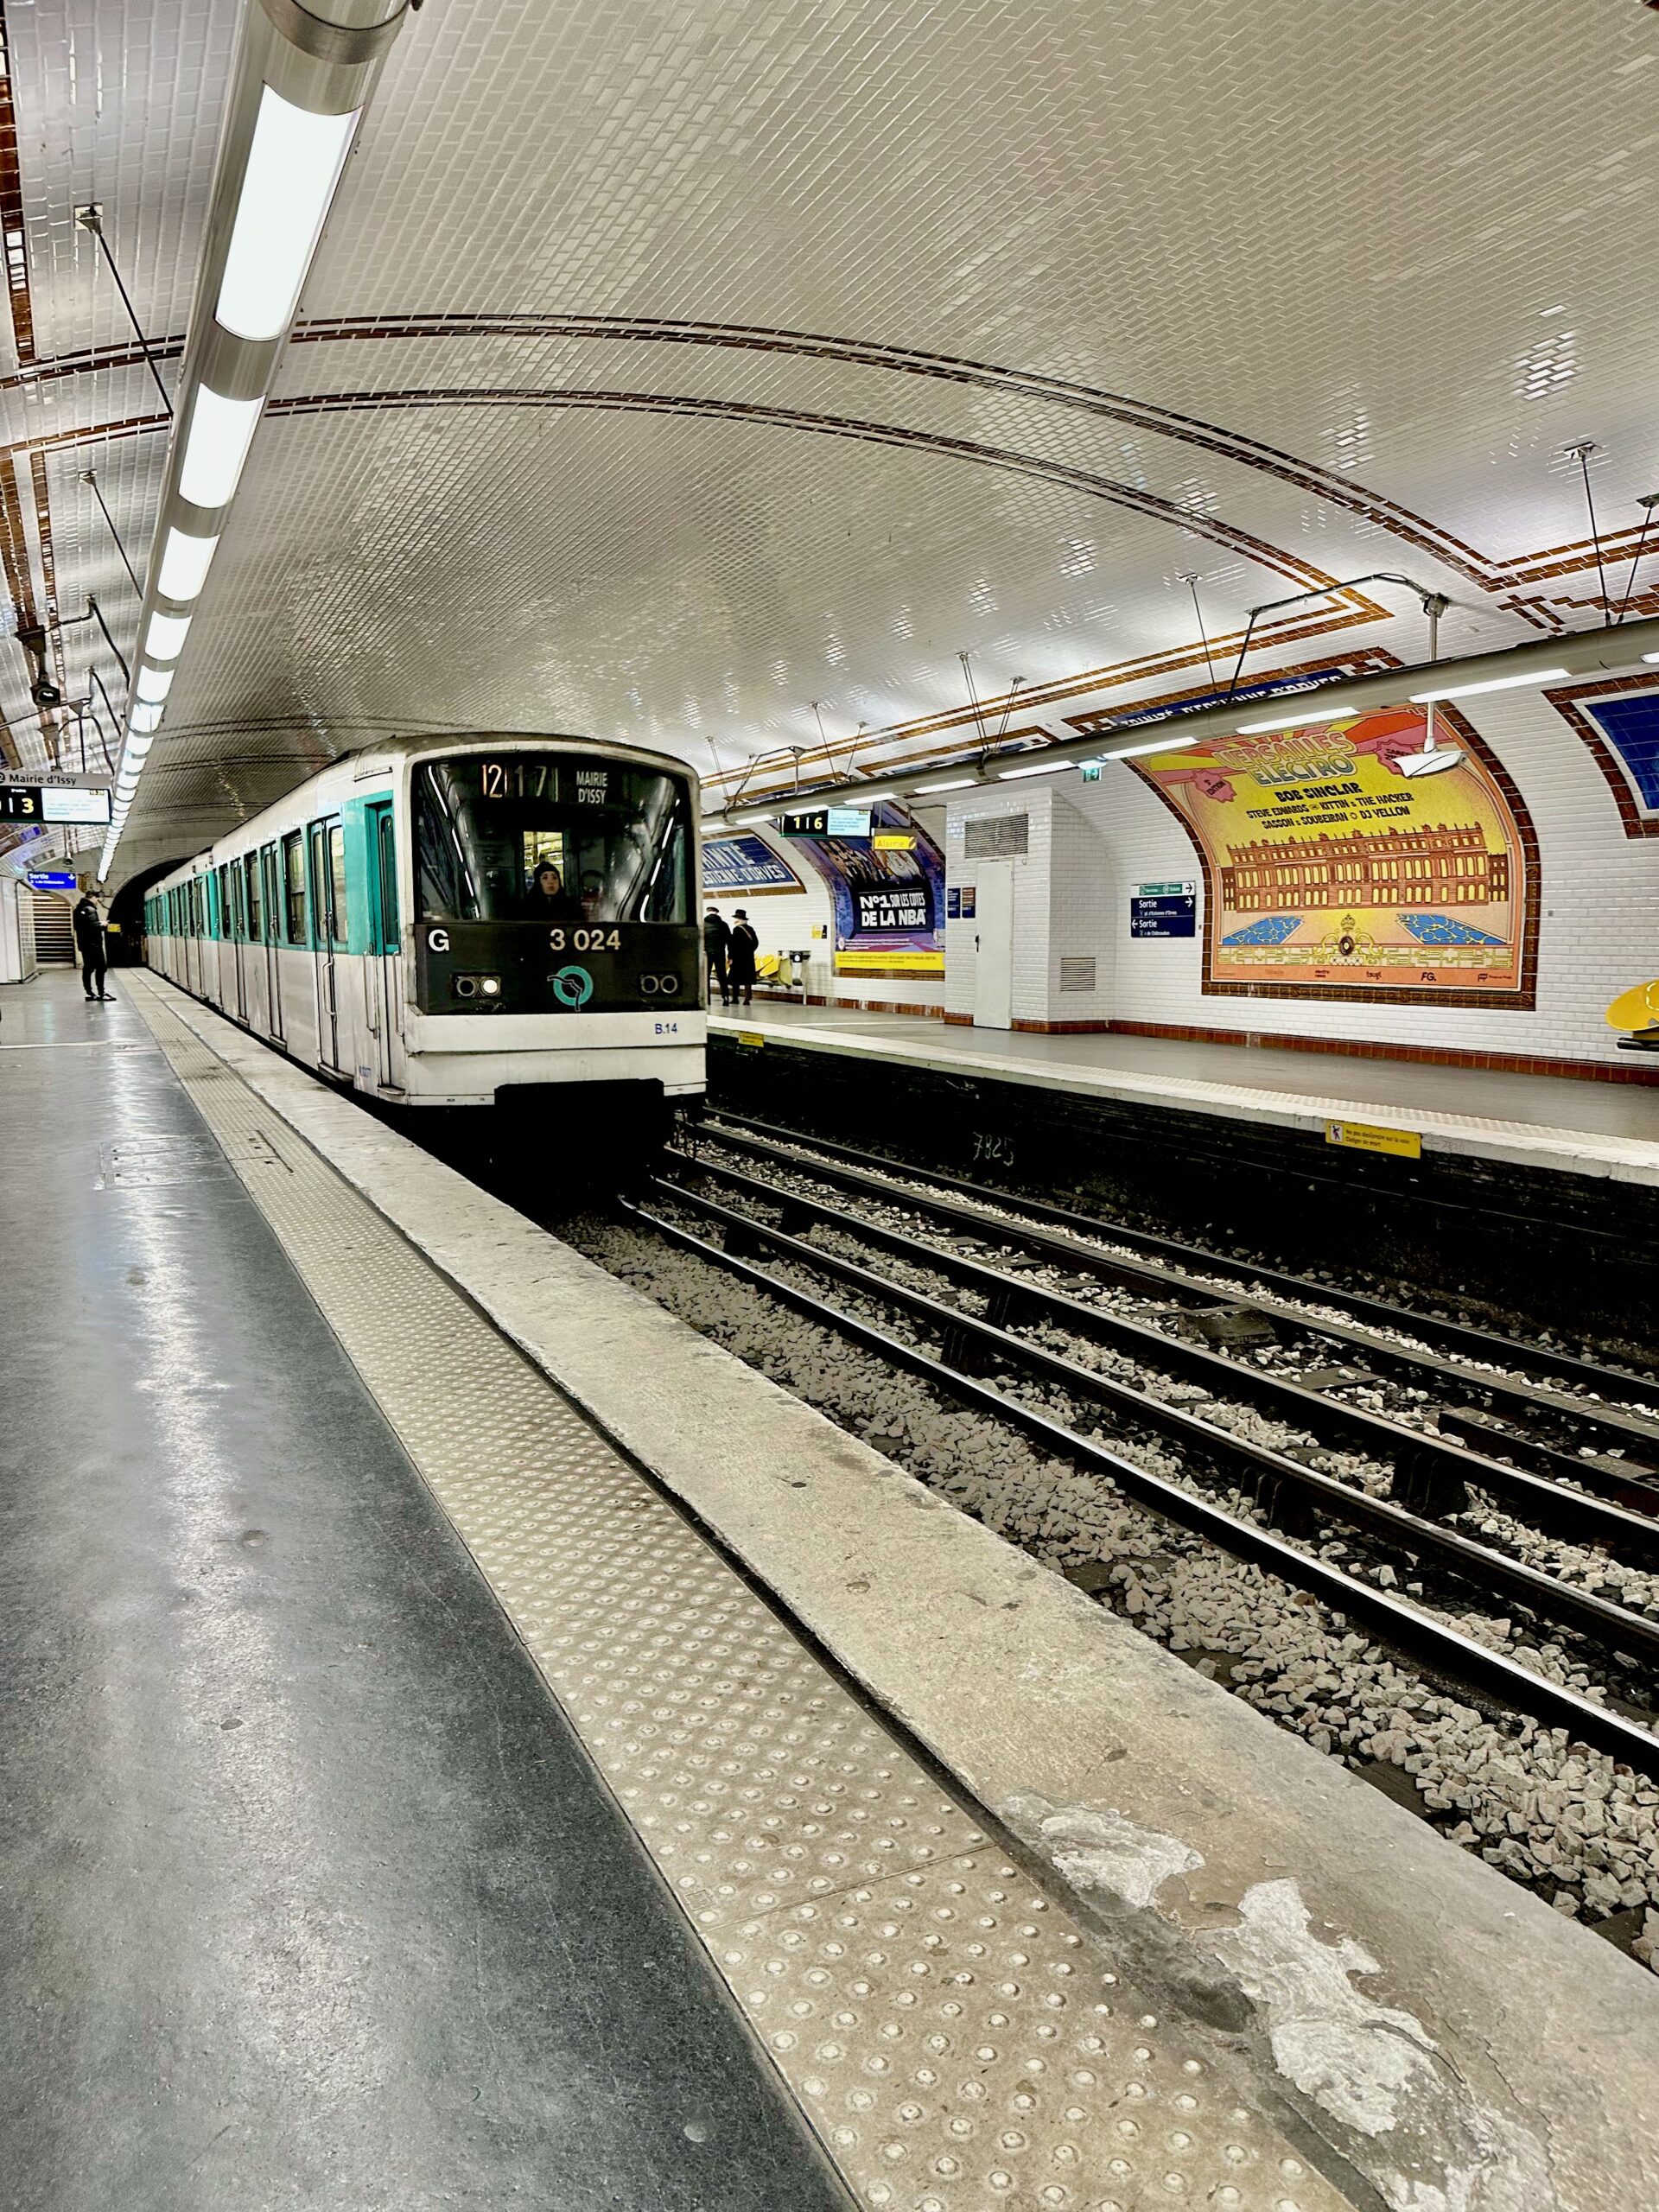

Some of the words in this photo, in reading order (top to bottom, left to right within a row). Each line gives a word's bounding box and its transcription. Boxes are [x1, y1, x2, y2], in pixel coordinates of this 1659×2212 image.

[1212, 732, 1356, 769] VERSAILLES
[1246, 753, 1355, 786] ELECTRO
[10, 774, 44, 784] Mairie
[47, 775, 77, 785] d'Issy
[576, 771, 608, 787] MAIRIE
[578, 788, 607, 804] D'ISSY
[1274, 790, 1304, 803] BOB
[1306, 782, 1363, 799] SINCLAR
[22, 798, 34, 814] 3
[1246, 809, 1272, 819] STEVE
[1273, 804, 1309, 816] EDWARDS
[1319, 799, 1351, 810] KITTIN
[1355, 796, 1376, 807] THE
[1377, 792, 1414, 804] HACKER
[793, 817, 801, 830] 1
[814, 817, 823, 830] 6
[1262, 818, 1295, 830] SASSON
[1302, 812, 1349, 826] SOUBEIRAN
[1361, 809, 1373, 820] DJ
[1374, 805, 1410, 818] YELLOW
[877, 839, 906, 848] Alarme
[739, 864, 786, 881] D'ORVES
[889, 893, 901, 908] SUR
[899, 893, 910, 907] LES
[1139, 899, 1157, 908] Sortie
[861, 911, 878, 927] DE
[880, 910, 896, 926] LA
[1139, 919, 1157, 928] Sortie
[428, 929, 450, 951] G
[655, 1022, 678, 1034] B.14
